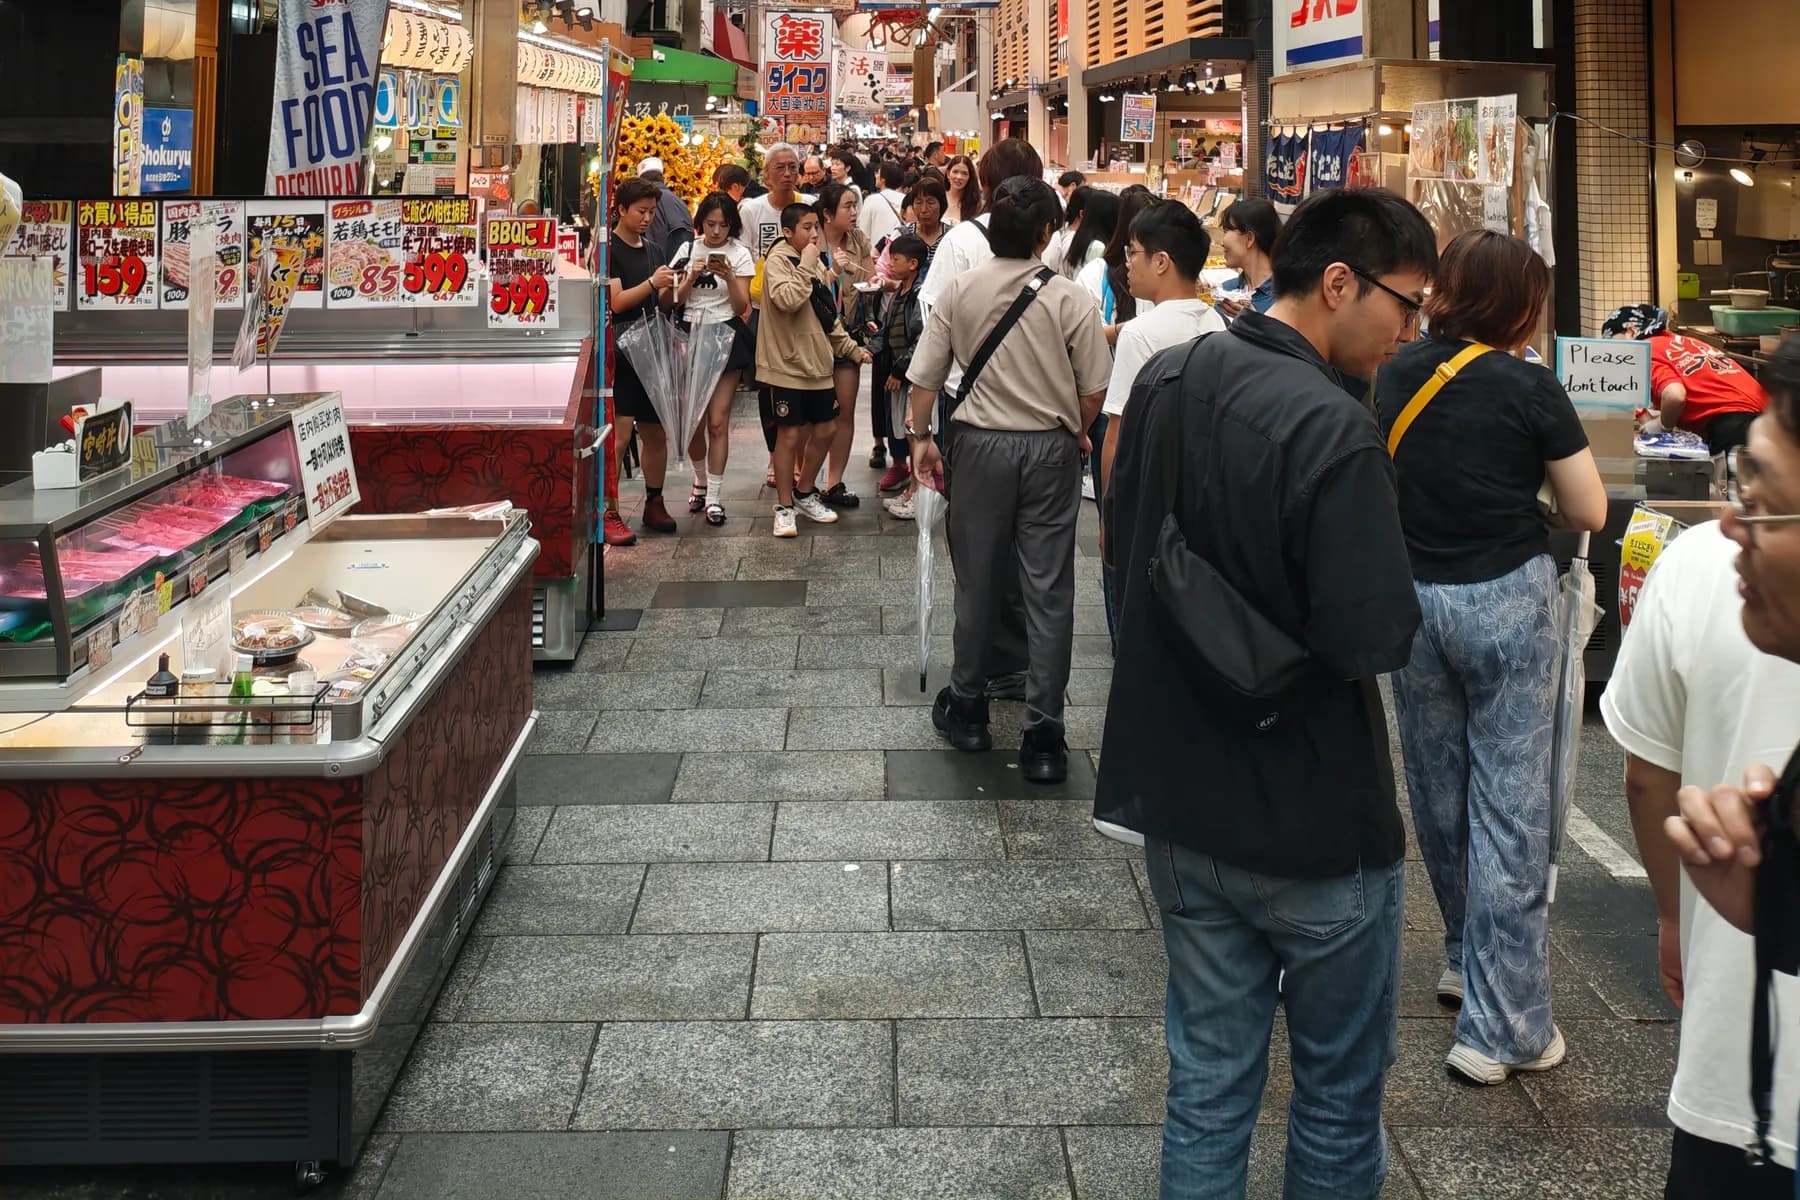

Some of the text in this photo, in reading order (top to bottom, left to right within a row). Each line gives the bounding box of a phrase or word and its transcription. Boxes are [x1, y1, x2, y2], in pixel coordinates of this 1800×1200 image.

[775, 14, 823, 59] 薬
[296, 12, 370, 92] SEA
[769, 65, 827, 94] ダイコク
[850, 56, 870, 76] 活
[281, 82, 373, 169] FOOD
[80, 201, 156, 226] お買い得品
[167, 204, 200, 218] 国内産
[80, 228, 113, 239] 国内産
[406, 226, 438, 237] 米国産
[81, 256, 147, 297] 159
[359, 265, 401, 295] 85
[403, 252, 469, 294] 599
[166, 289, 186, 300] 100g
[333, 288, 353, 298] 100g
[491, 274, 549, 316] 599
[1570, 344, 1636, 366] Please
[1564, 373, 1639, 394] don't touch
[297, 405, 342, 442] 店内购买的肉
